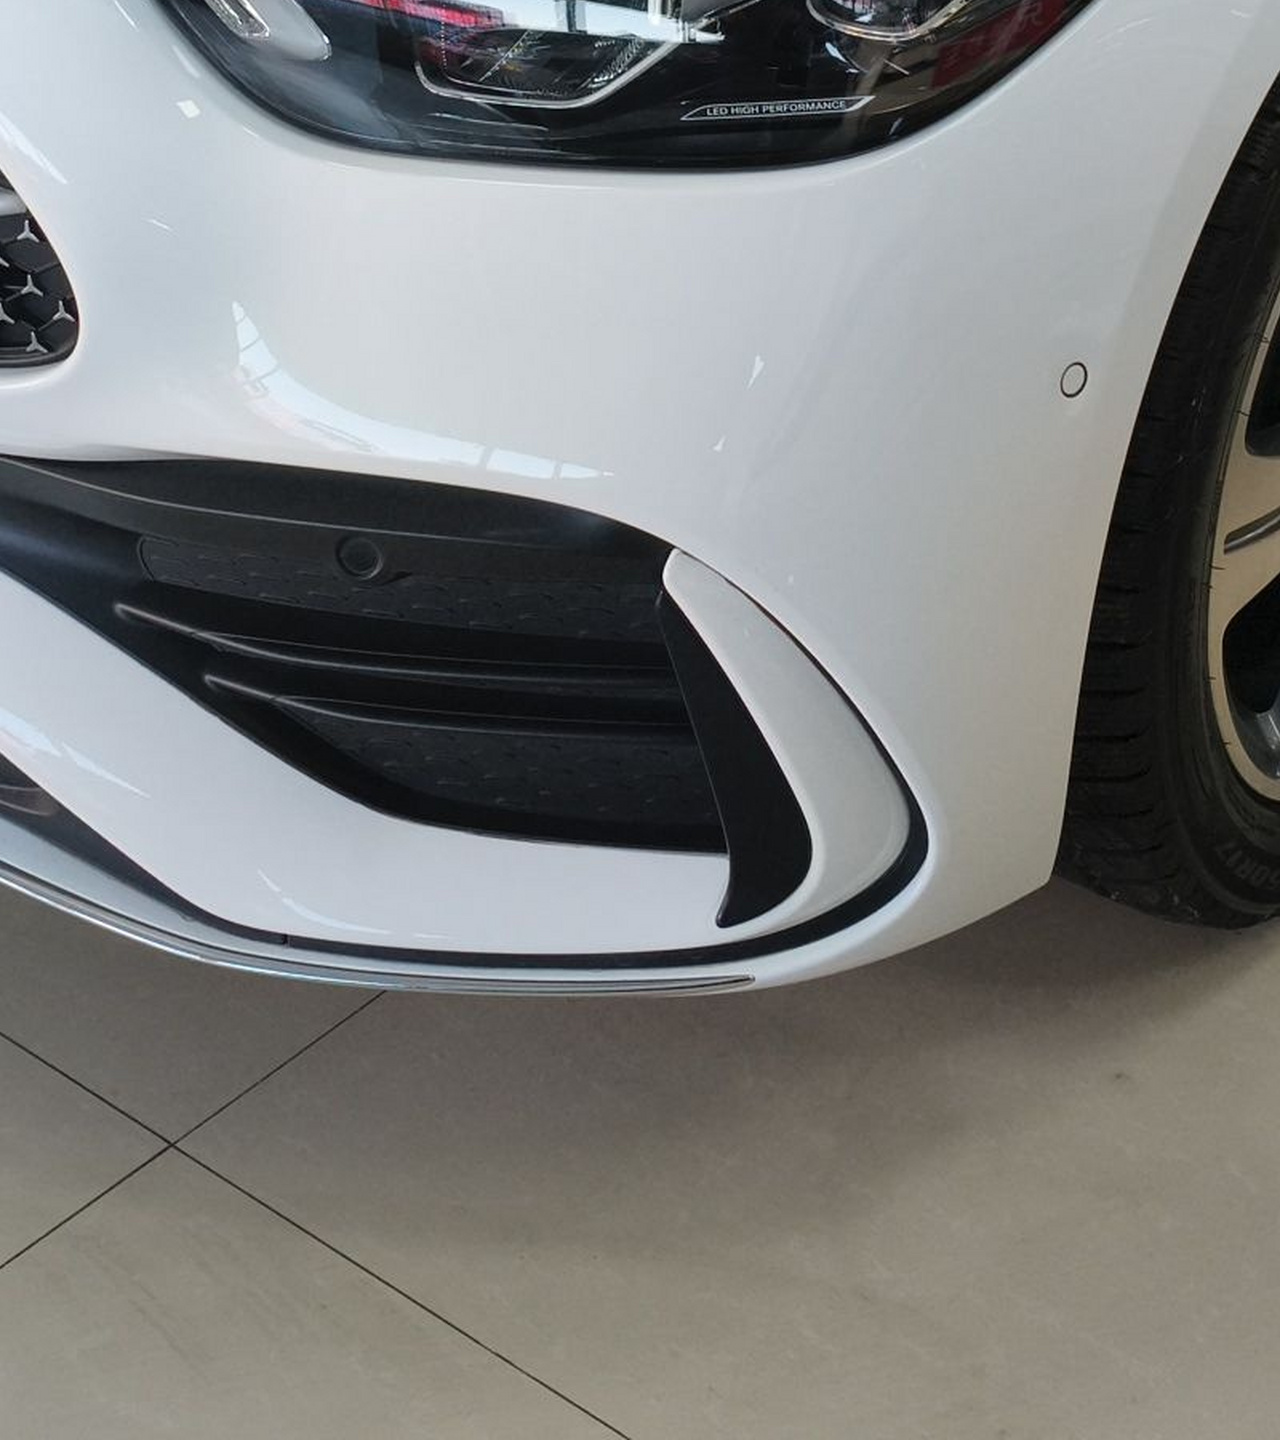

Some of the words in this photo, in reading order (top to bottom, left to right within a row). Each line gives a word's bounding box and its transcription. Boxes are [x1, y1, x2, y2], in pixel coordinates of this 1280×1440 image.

[705, 106, 728, 117] LED
[730, 105, 760, 115] HIGH
[762, 100, 846, 114] PERFORMANCE
